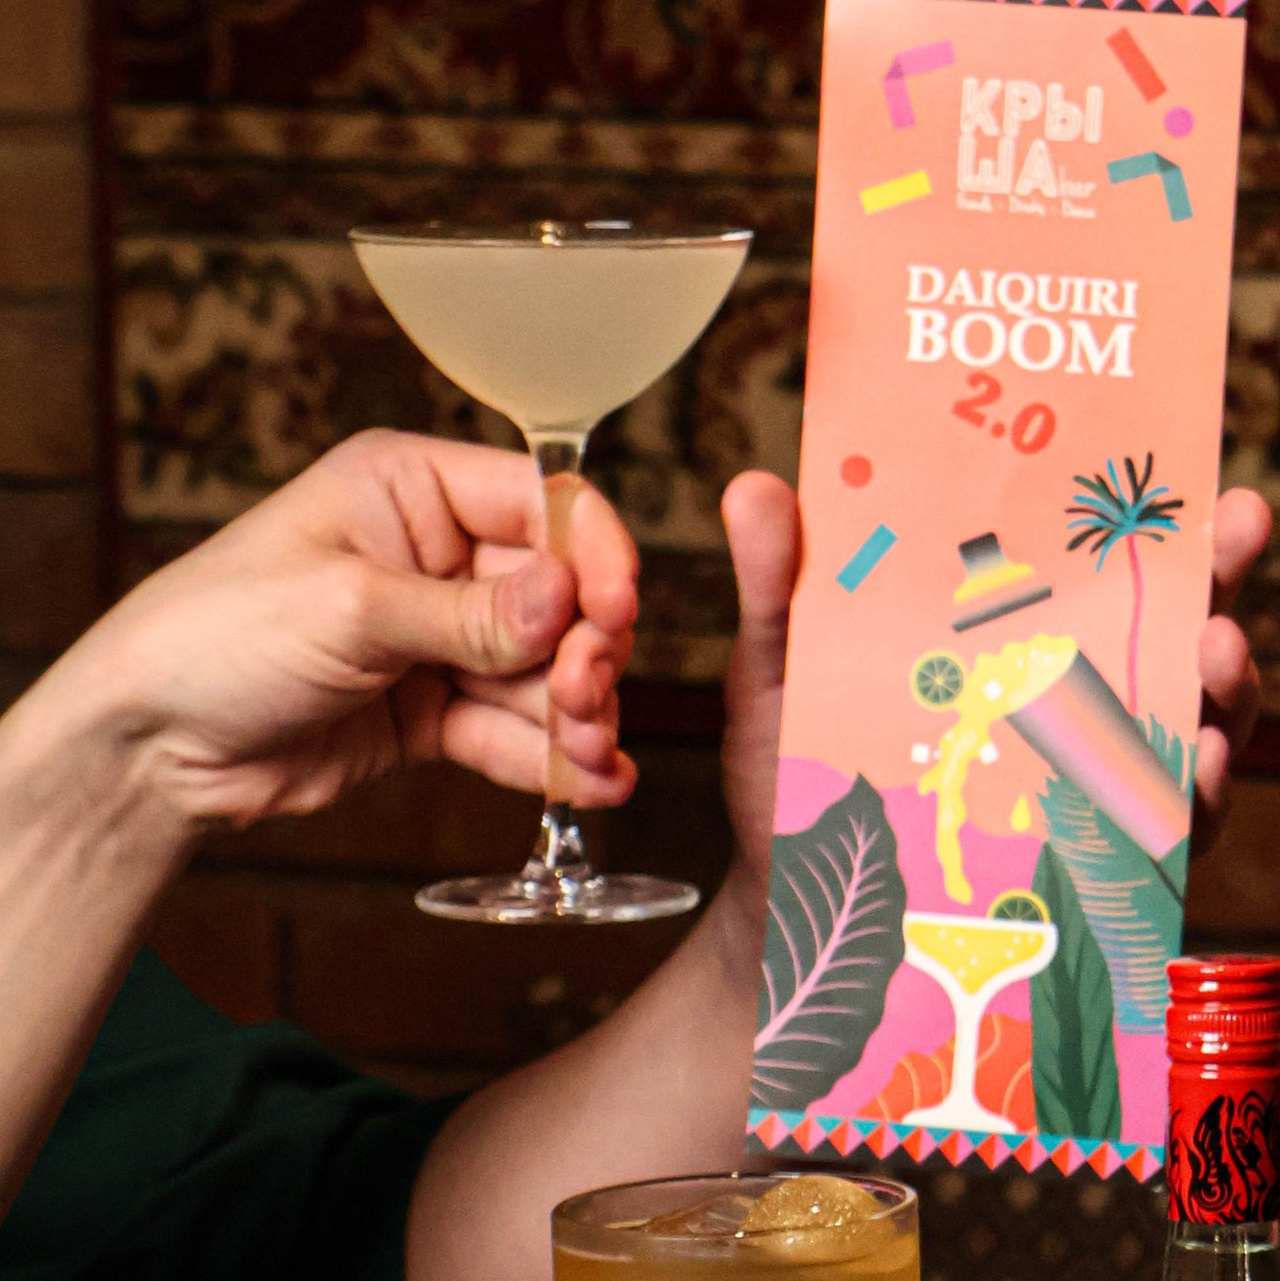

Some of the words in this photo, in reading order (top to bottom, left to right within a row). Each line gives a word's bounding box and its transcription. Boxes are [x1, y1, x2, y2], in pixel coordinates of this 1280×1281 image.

[960, 76, 1103, 143] КРЫ
[906, 265, 1138, 319] DAIQUIRI
[905, 307, 1137, 378] BOOM
[951, 371, 1057, 455] 2.0
